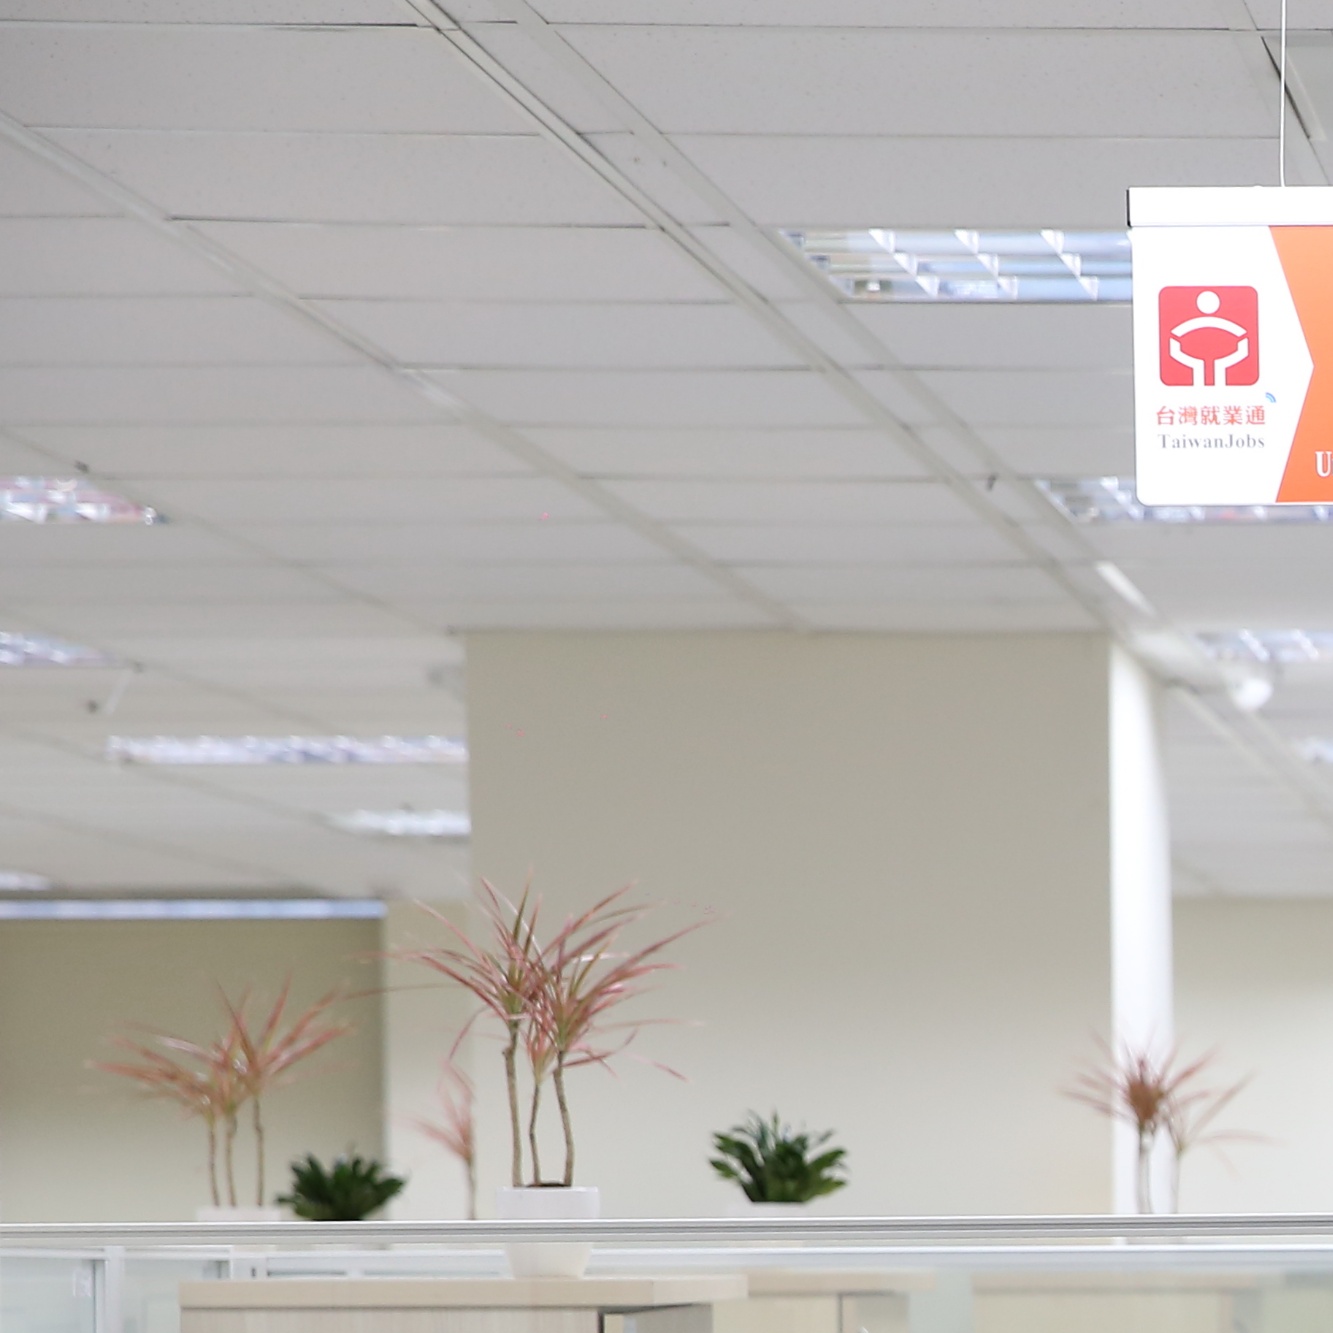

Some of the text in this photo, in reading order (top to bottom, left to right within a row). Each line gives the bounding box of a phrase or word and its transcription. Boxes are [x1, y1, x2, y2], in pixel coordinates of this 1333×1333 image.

[1156, 405, 1266, 426] 台灣就業通
[1157, 433, 1265, 449] TaiwanJobs
